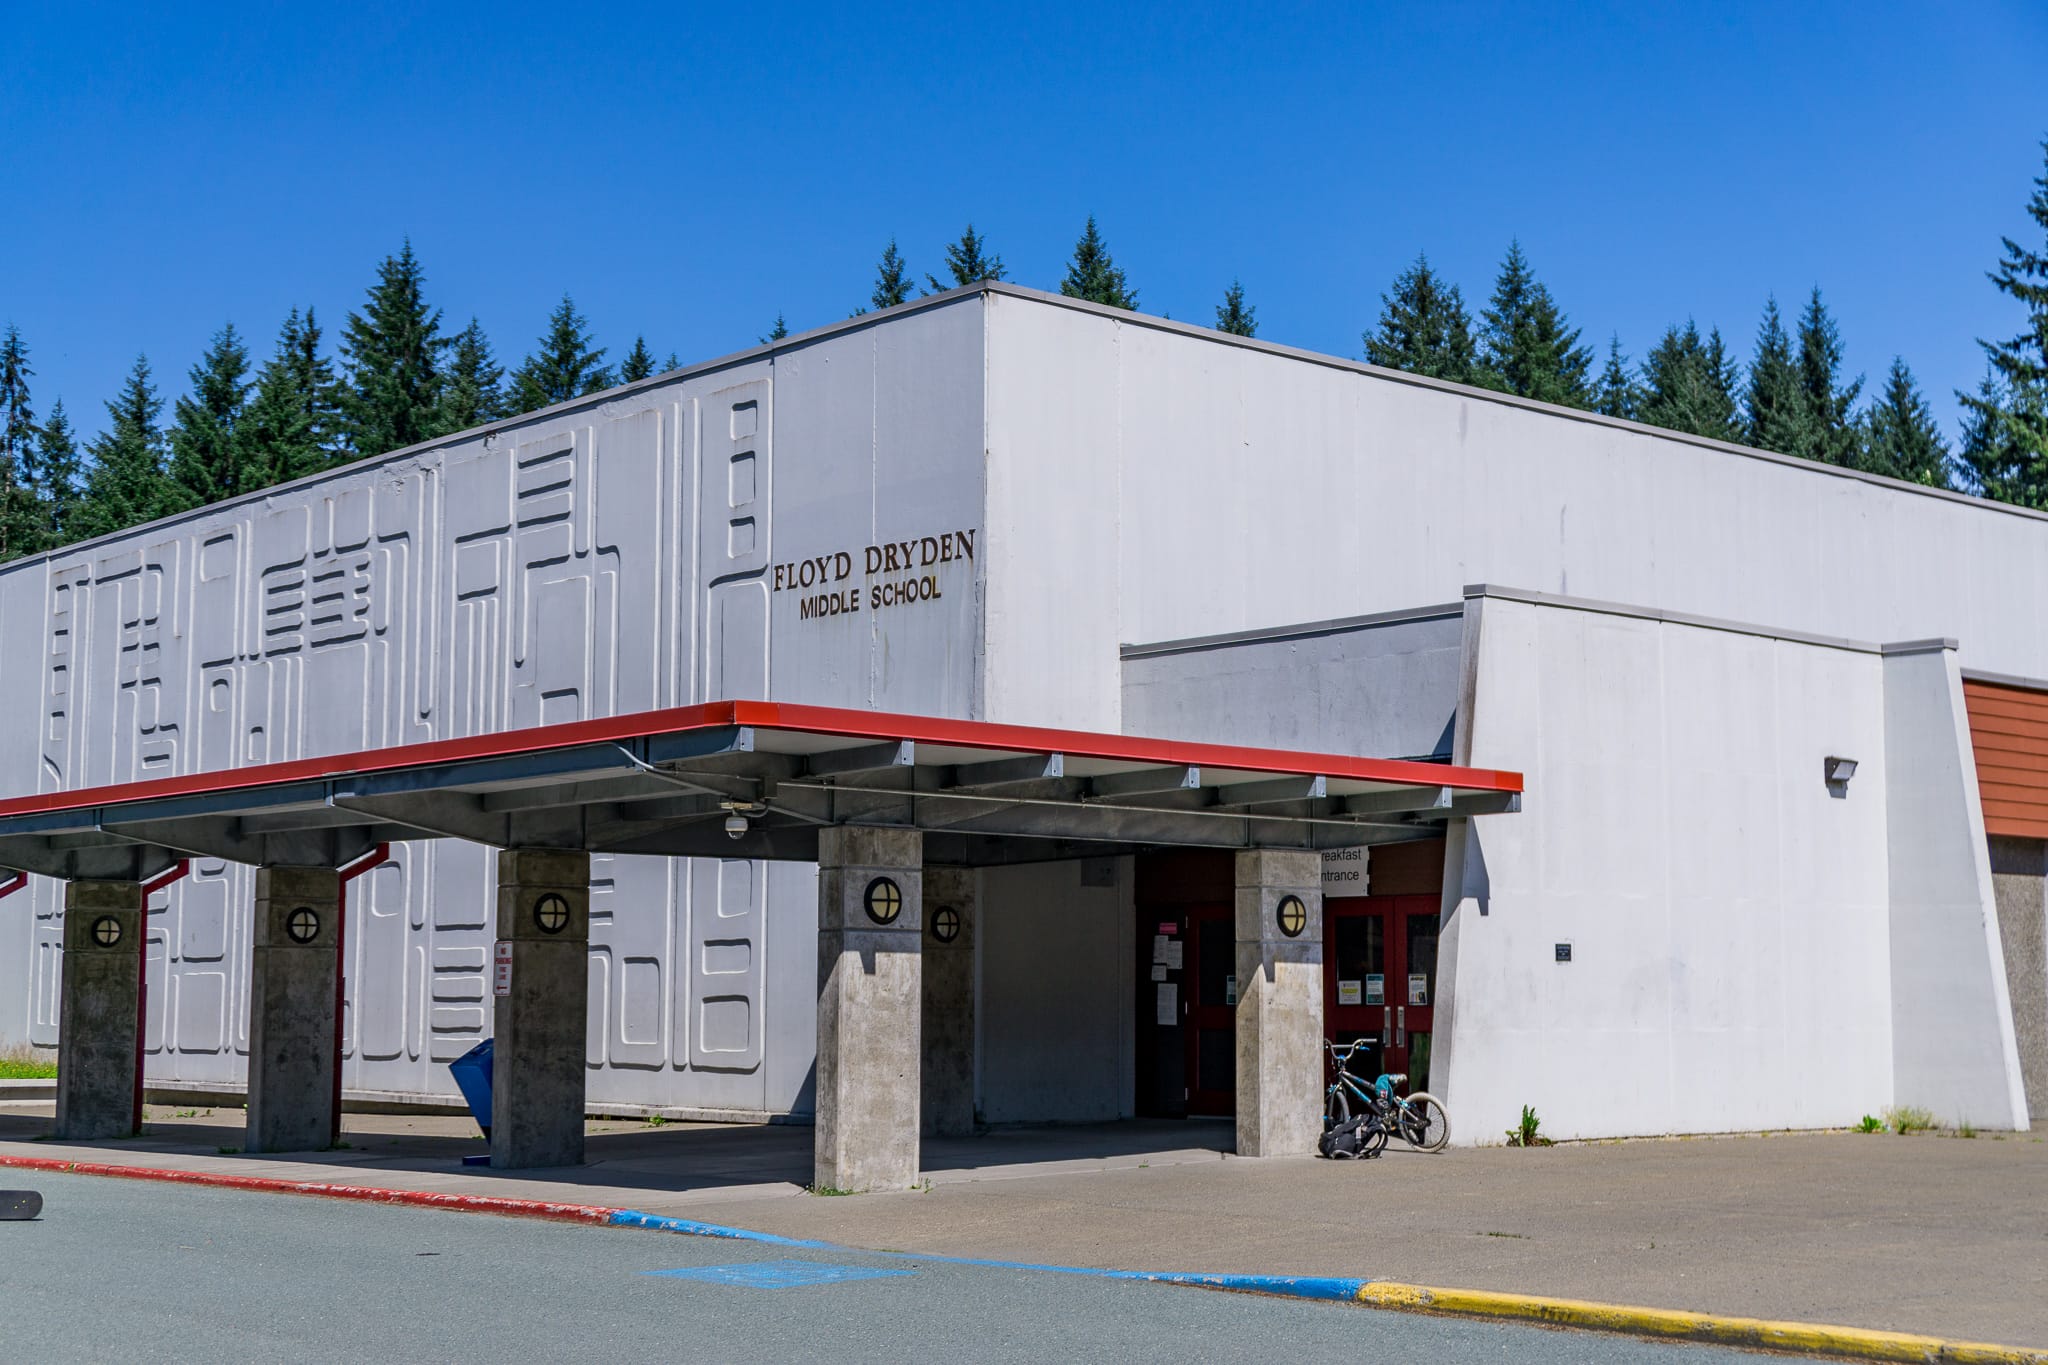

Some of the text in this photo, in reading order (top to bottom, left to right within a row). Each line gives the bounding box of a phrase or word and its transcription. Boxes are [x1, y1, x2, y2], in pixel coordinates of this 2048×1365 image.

[774, 529, 976, 592] FLOYD DRYDEN
[801, 576, 941, 620] MIDDLE SCHOOL
[1321, 848, 1361, 861] reakfast
[1321, 870, 1359, 882] ntrance
